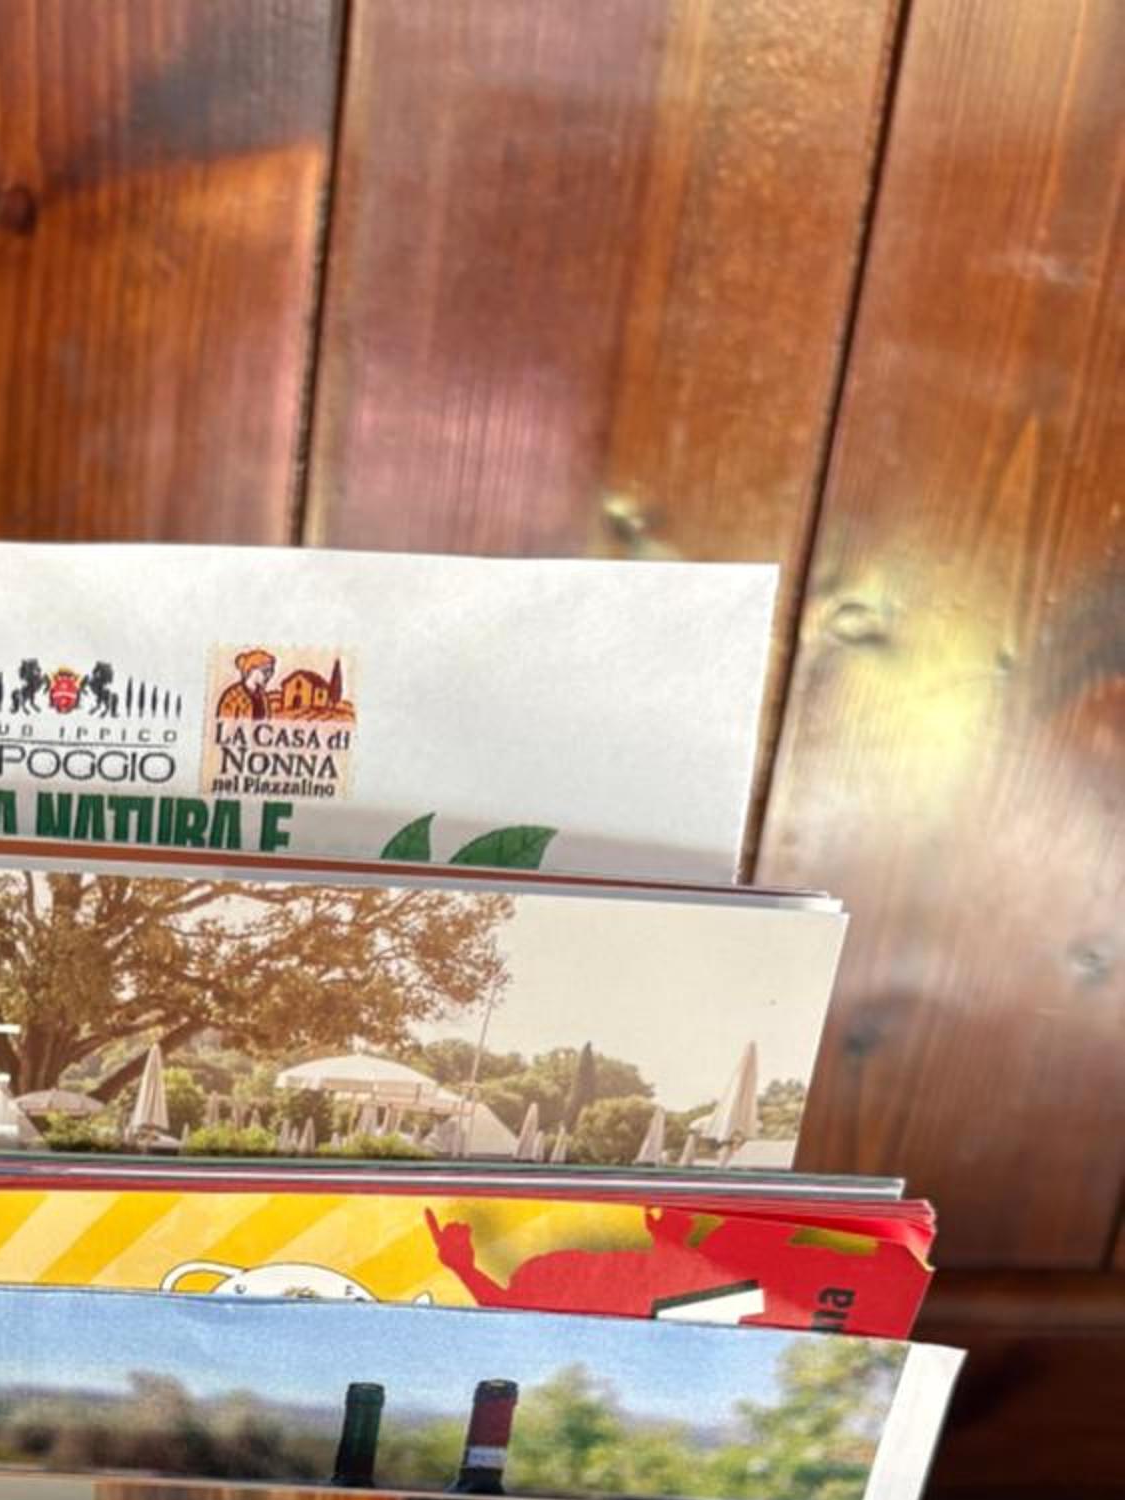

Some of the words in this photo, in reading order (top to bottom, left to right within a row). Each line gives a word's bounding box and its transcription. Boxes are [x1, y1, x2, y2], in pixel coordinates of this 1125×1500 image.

[59, 726, 178, 745] IPPICO
[215, 721, 248, 748] LA
[251, 723, 320, 751] CASA
[327, 729, 352, 751] di
[220, 746, 339, 781] NONNA
[211, 776, 241, 795] nel
[242, 777, 335, 798] Piazzalino
